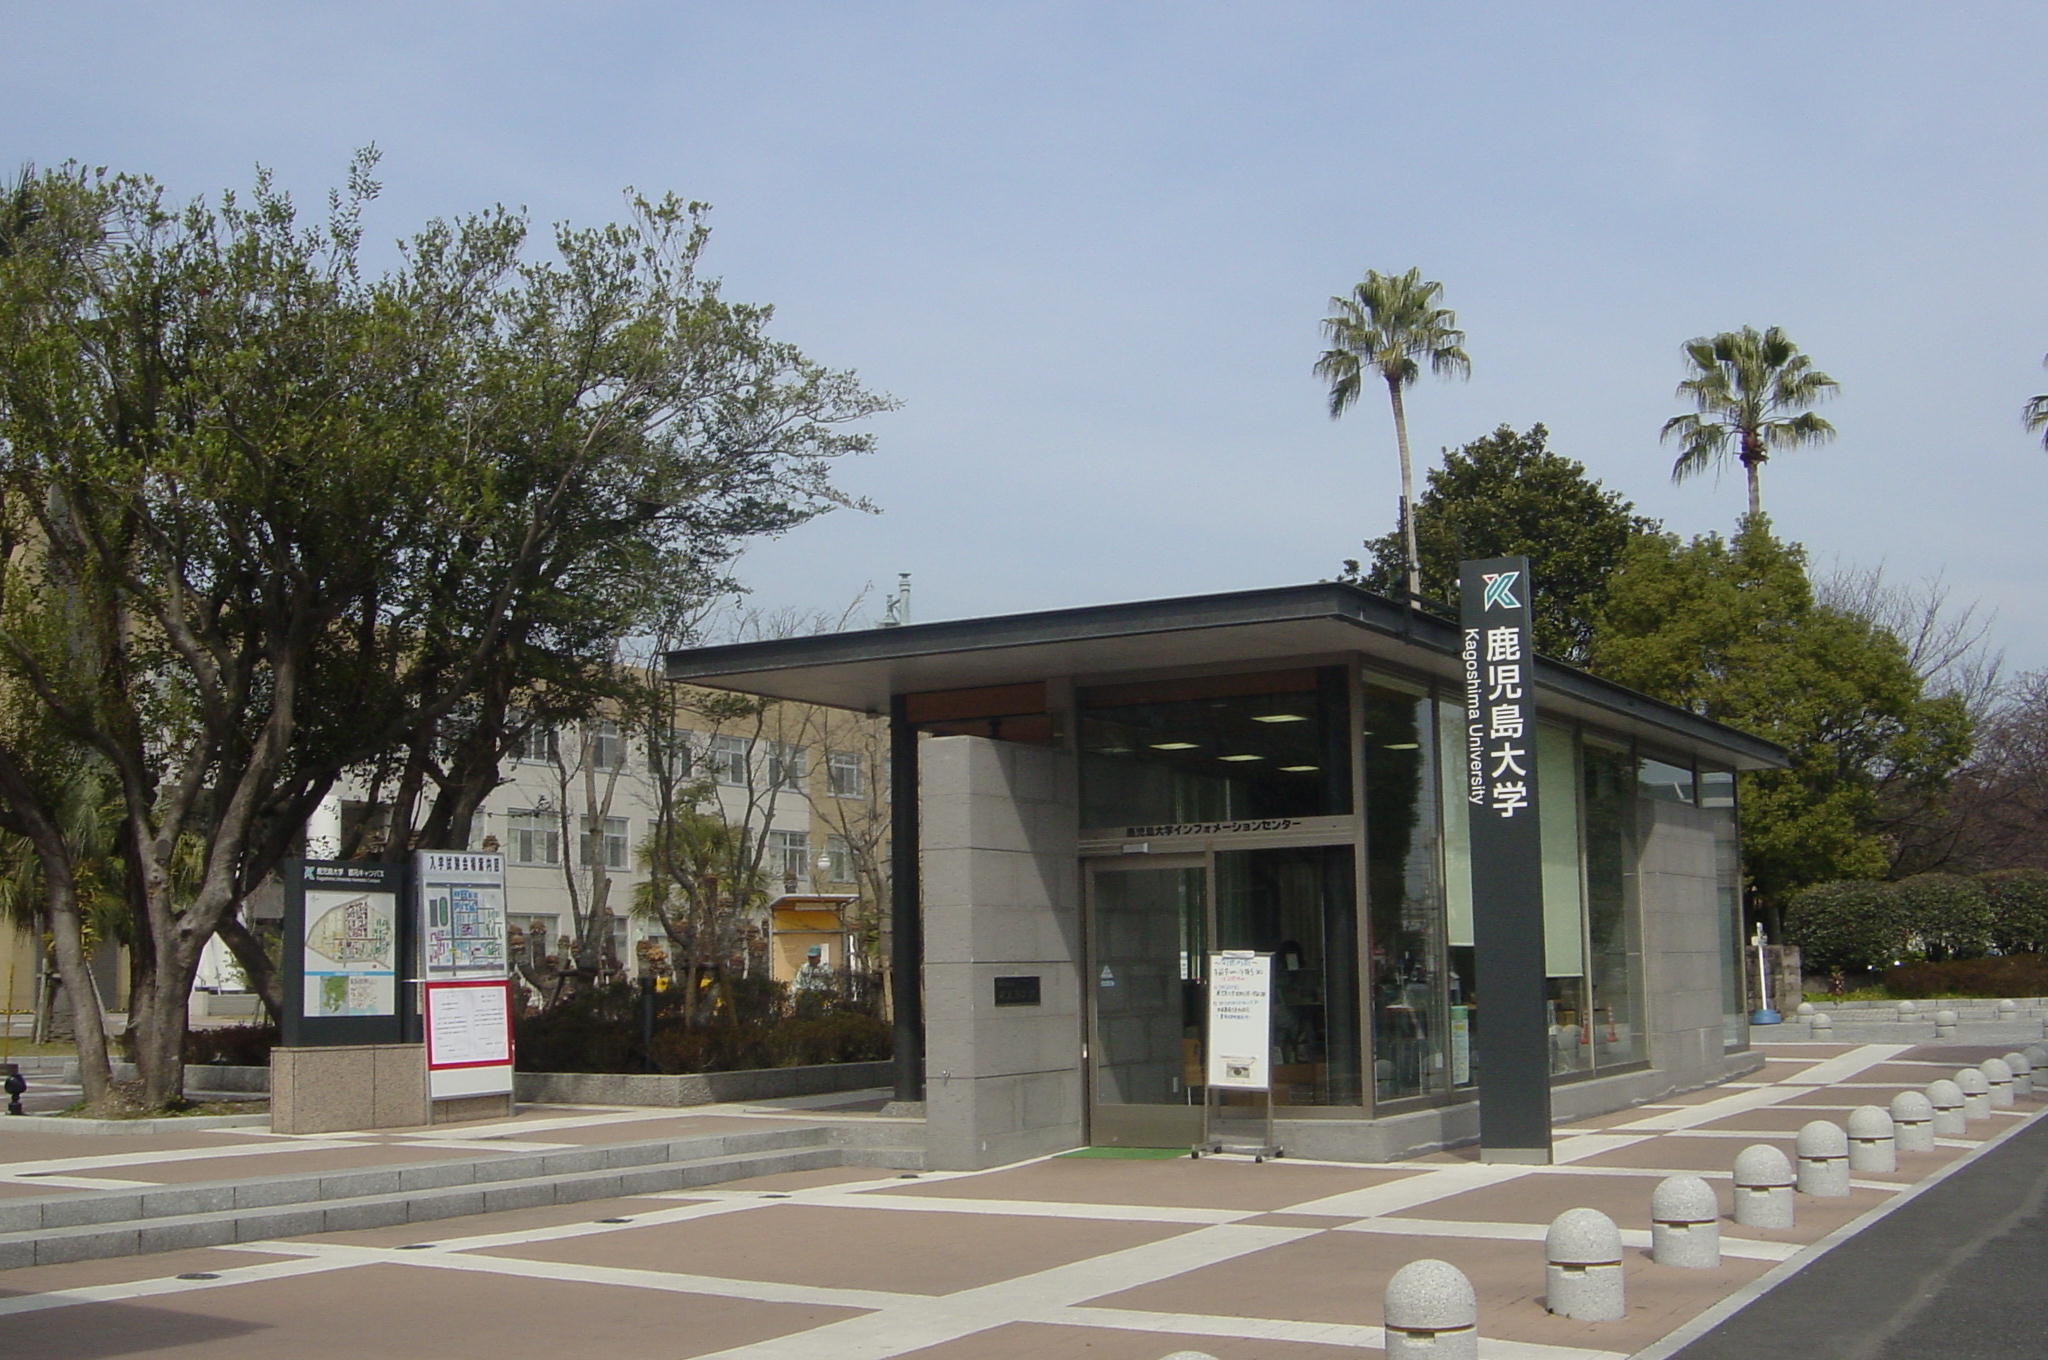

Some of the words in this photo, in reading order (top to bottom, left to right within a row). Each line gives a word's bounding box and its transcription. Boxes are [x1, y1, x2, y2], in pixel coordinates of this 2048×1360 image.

[1463, 628, 1481, 719] Kagoshima
[1467, 724, 1484, 805] University
[1487, 626, 1528, 817] 鹿児島大学
